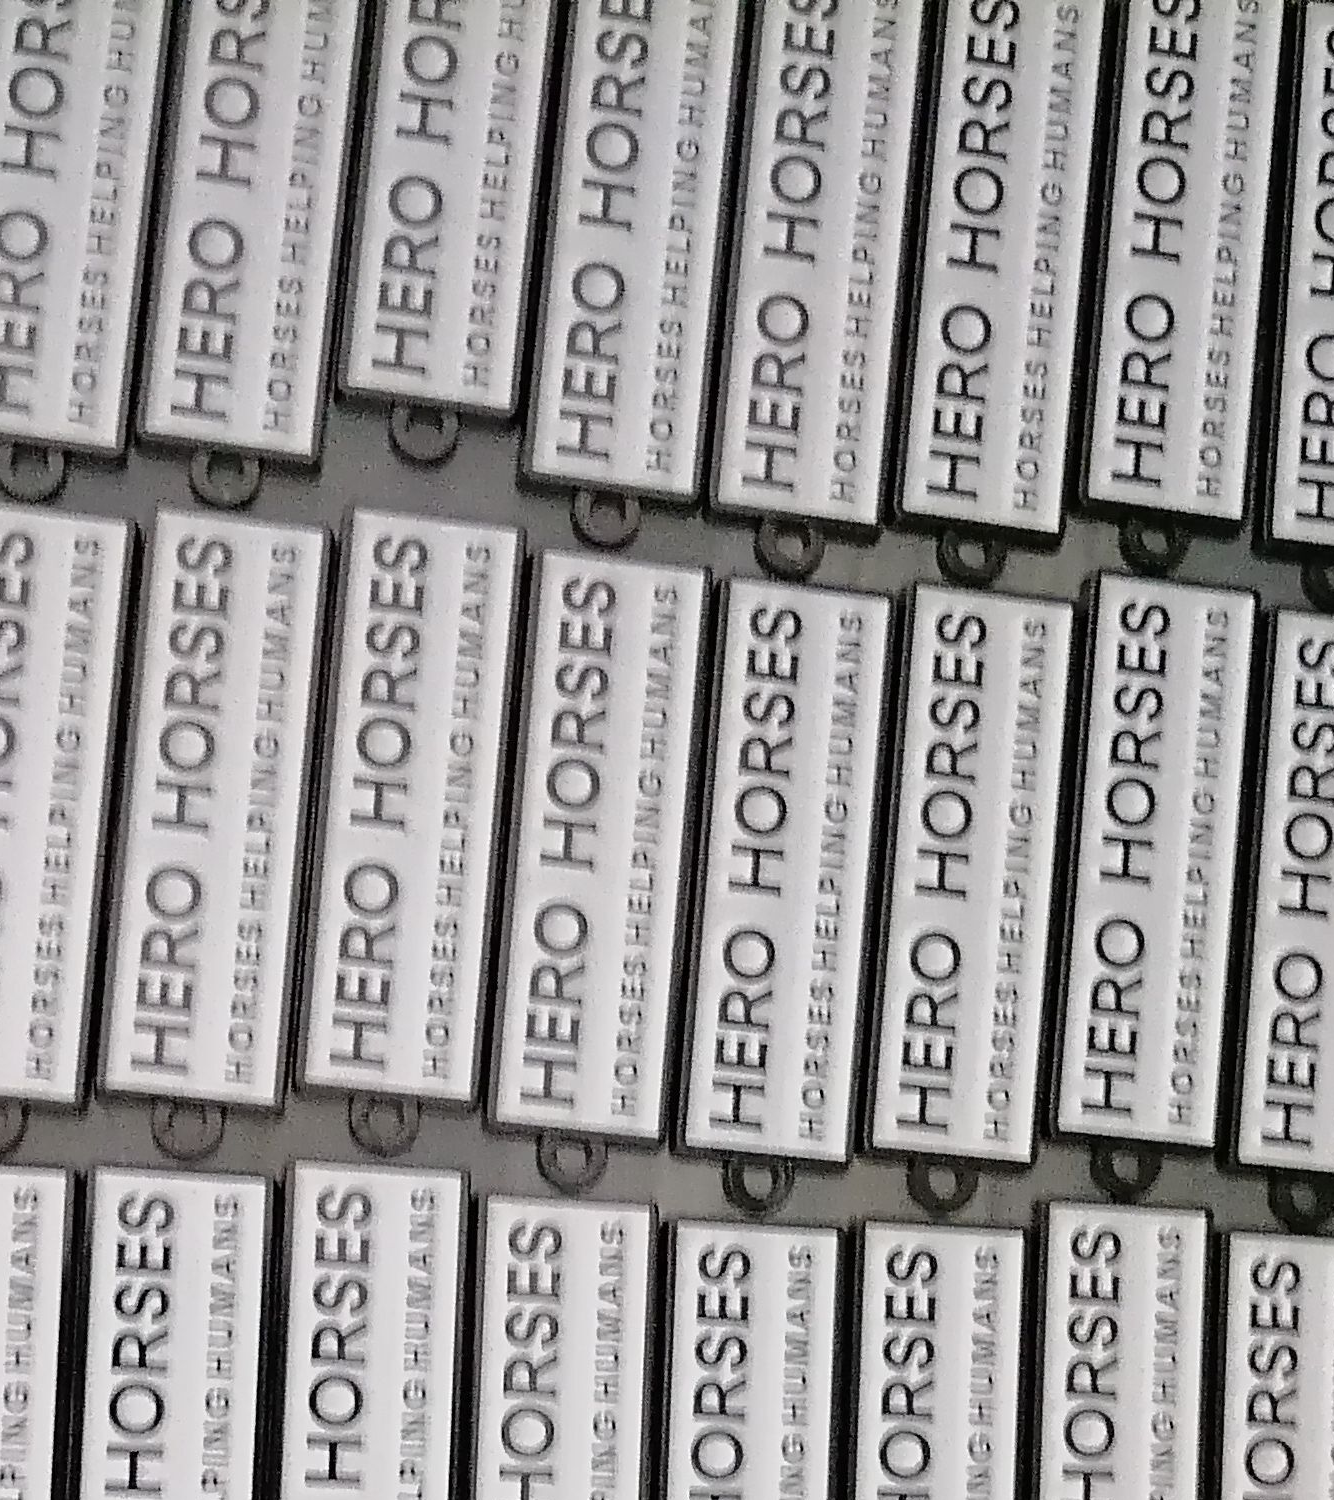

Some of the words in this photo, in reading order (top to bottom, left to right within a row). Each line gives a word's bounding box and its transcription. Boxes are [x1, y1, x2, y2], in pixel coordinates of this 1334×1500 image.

[279, 90, 326, 266] HELPING
[946, 0, 1023, 275] HORSES
[169, 214, 248, 424] HERO
[260, 271, 307, 434] HORSES
[555, 257, 629, 464] HERO
[925, 299, 995, 503] HERO
[350, 532, 431, 832] HORSES
[450, 542, 494, 723] HUMANS
[540, 574, 619, 872] HORSES
[1192, 608, 1233, 782] HUMANS
[434, 728, 478, 907] HELPING
[914, 609, 990, 902] HORSES
[1099, 599, 1173, 888] HORSES
[329, 859, 403, 1069] HERO
[1179, 787, 1219, 960] HELPING
[420, 914, 462, 1077] HORSES
[520, 899, 592, 1107] HERO
[896, 928, 965, 1133] HERO
[1081, 914, 1149, 1117] HERO
[1166, 967, 1205, 1124] HORSES
[304, 1186, 374, 1487] HORSES
